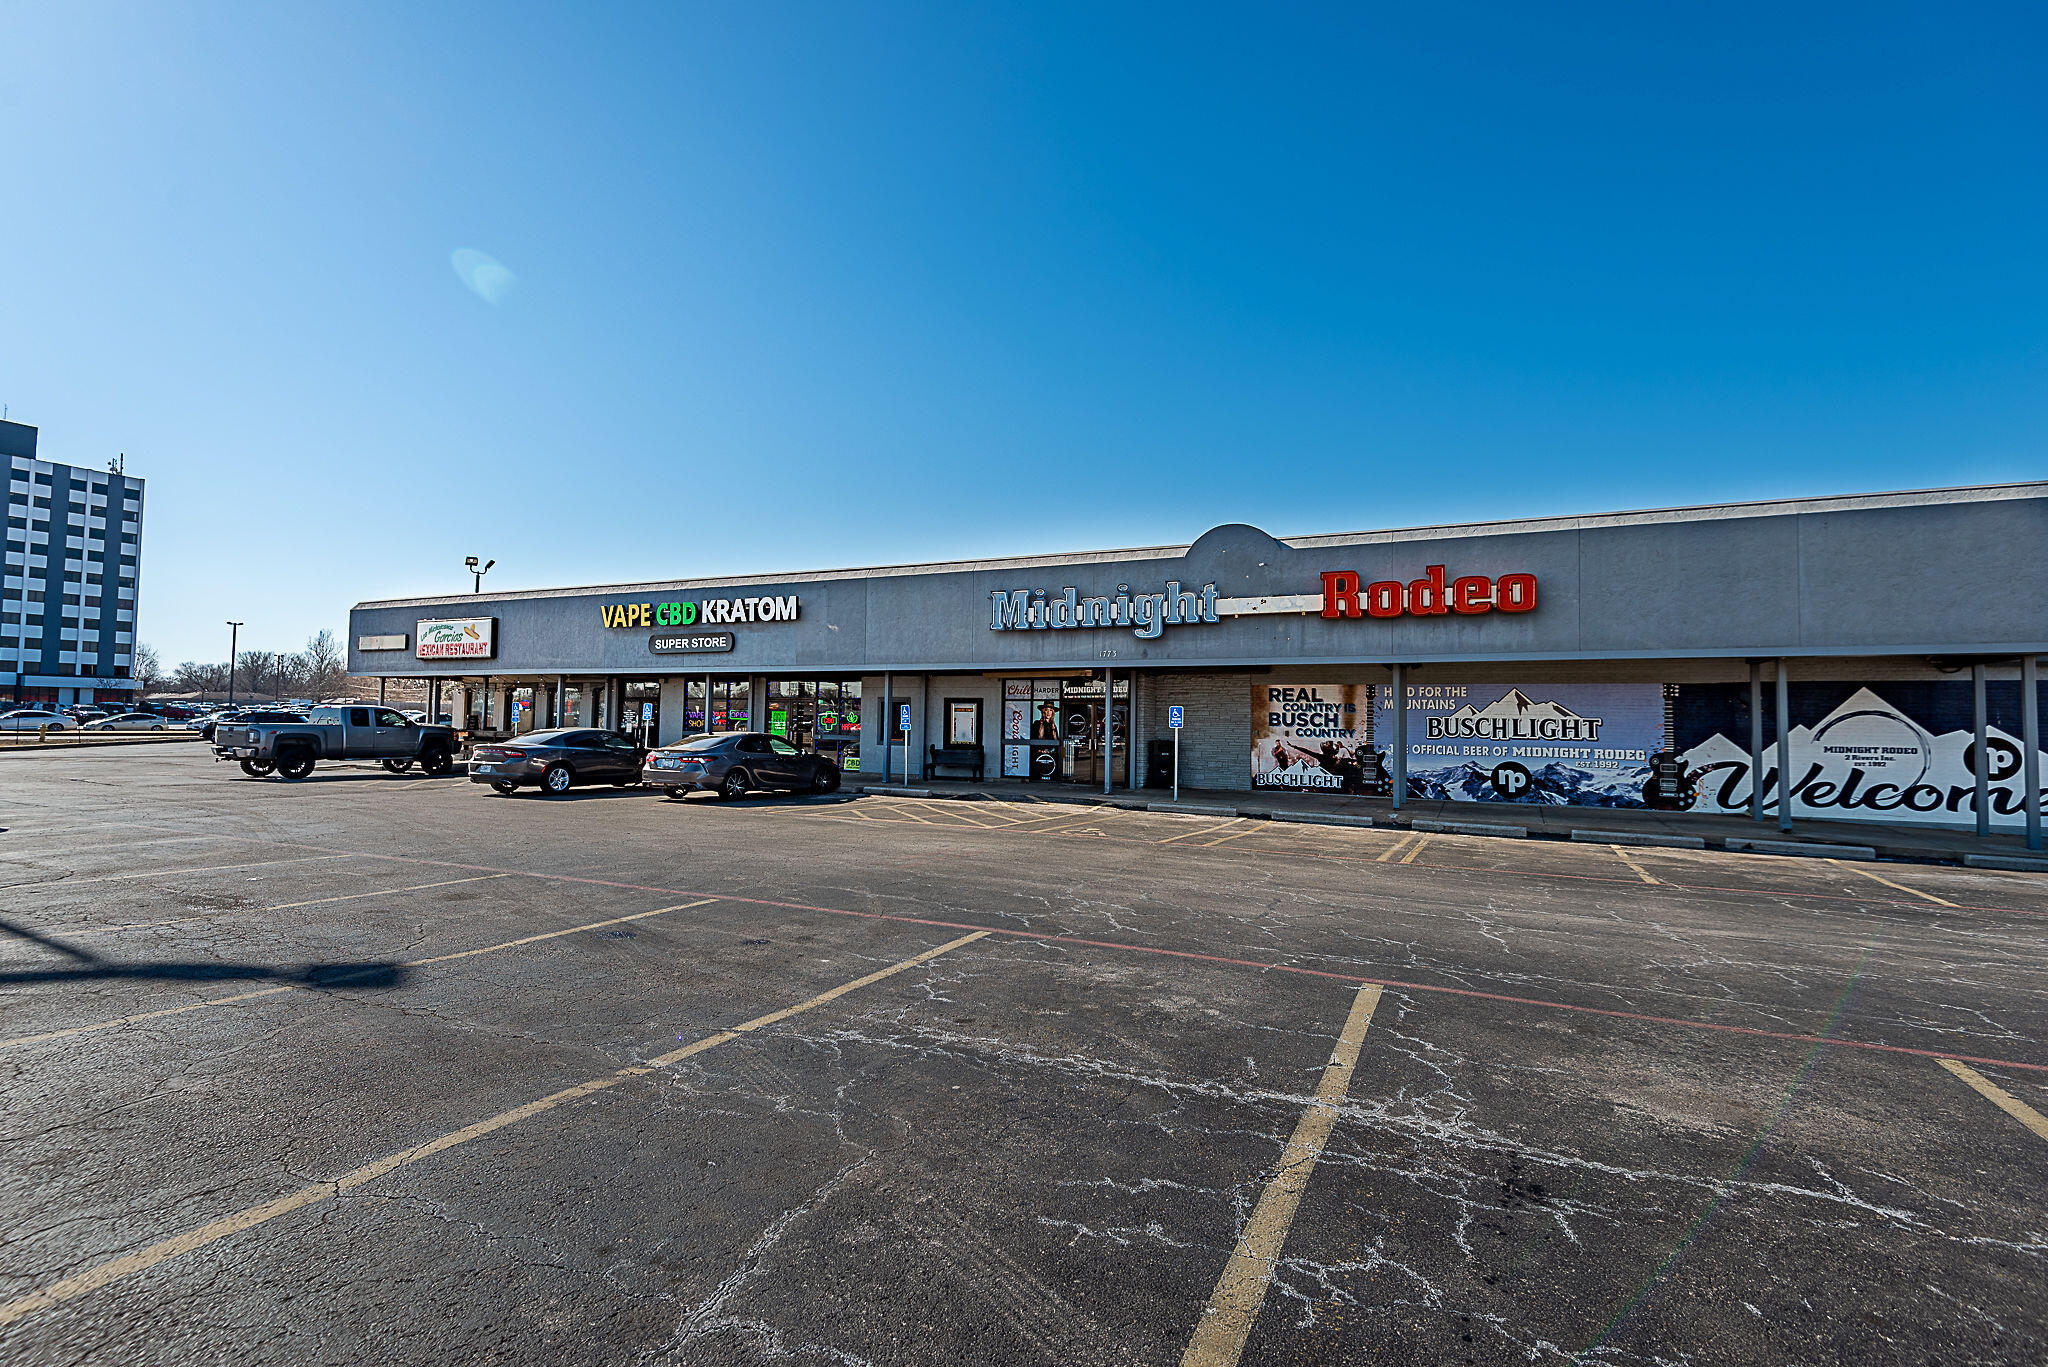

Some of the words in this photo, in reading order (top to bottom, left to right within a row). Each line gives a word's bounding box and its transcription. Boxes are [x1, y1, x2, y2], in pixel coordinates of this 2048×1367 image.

[1320, 564, 1538, 620] Rodeo
[600, 603, 651, 628] VAPE
[656, 601, 697, 627] CBD
[701, 595, 798, 624] KRATOM
[989, 580, 1220, 640] Midnight
[418, 643, 444, 657] MEXICAN
[445, 642, 488, 656] RESTAURANT
[654, 637, 689, 650] SUPER
[691, 636, 727, 648] STORE
[1063, 686, 1101, 694] MIDNIGHT
[1268, 687, 1324, 703] REAL
[1384, 686, 1415, 697] HD
[1419, 686, 1441, 697] FOR
[1445, 686, 1467, 697] THE
[1282, 702, 1342, 713] COUNTRY
[1344, 703, 1357, 713] IS
[1384, 699, 1456, 710] MUNTAINS
[1268, 712, 1339, 728] BUSCH
[1295, 727, 1357, 738] COUNTRY
[1412, 744, 1460, 756] OFFICIAL
[1463, 746, 1490, 757] BEER
[1493, 746, 1508, 757] OF
[1512, 746, 1590, 760] MIDNIGHT
[1823, 746, 1880, 754] MIDNIGHT
[1881, 747, 1918, 755] RODEO
[1594, 761, 1619, 769] 1992
[1691, 761, 2048, 816] Welcom
